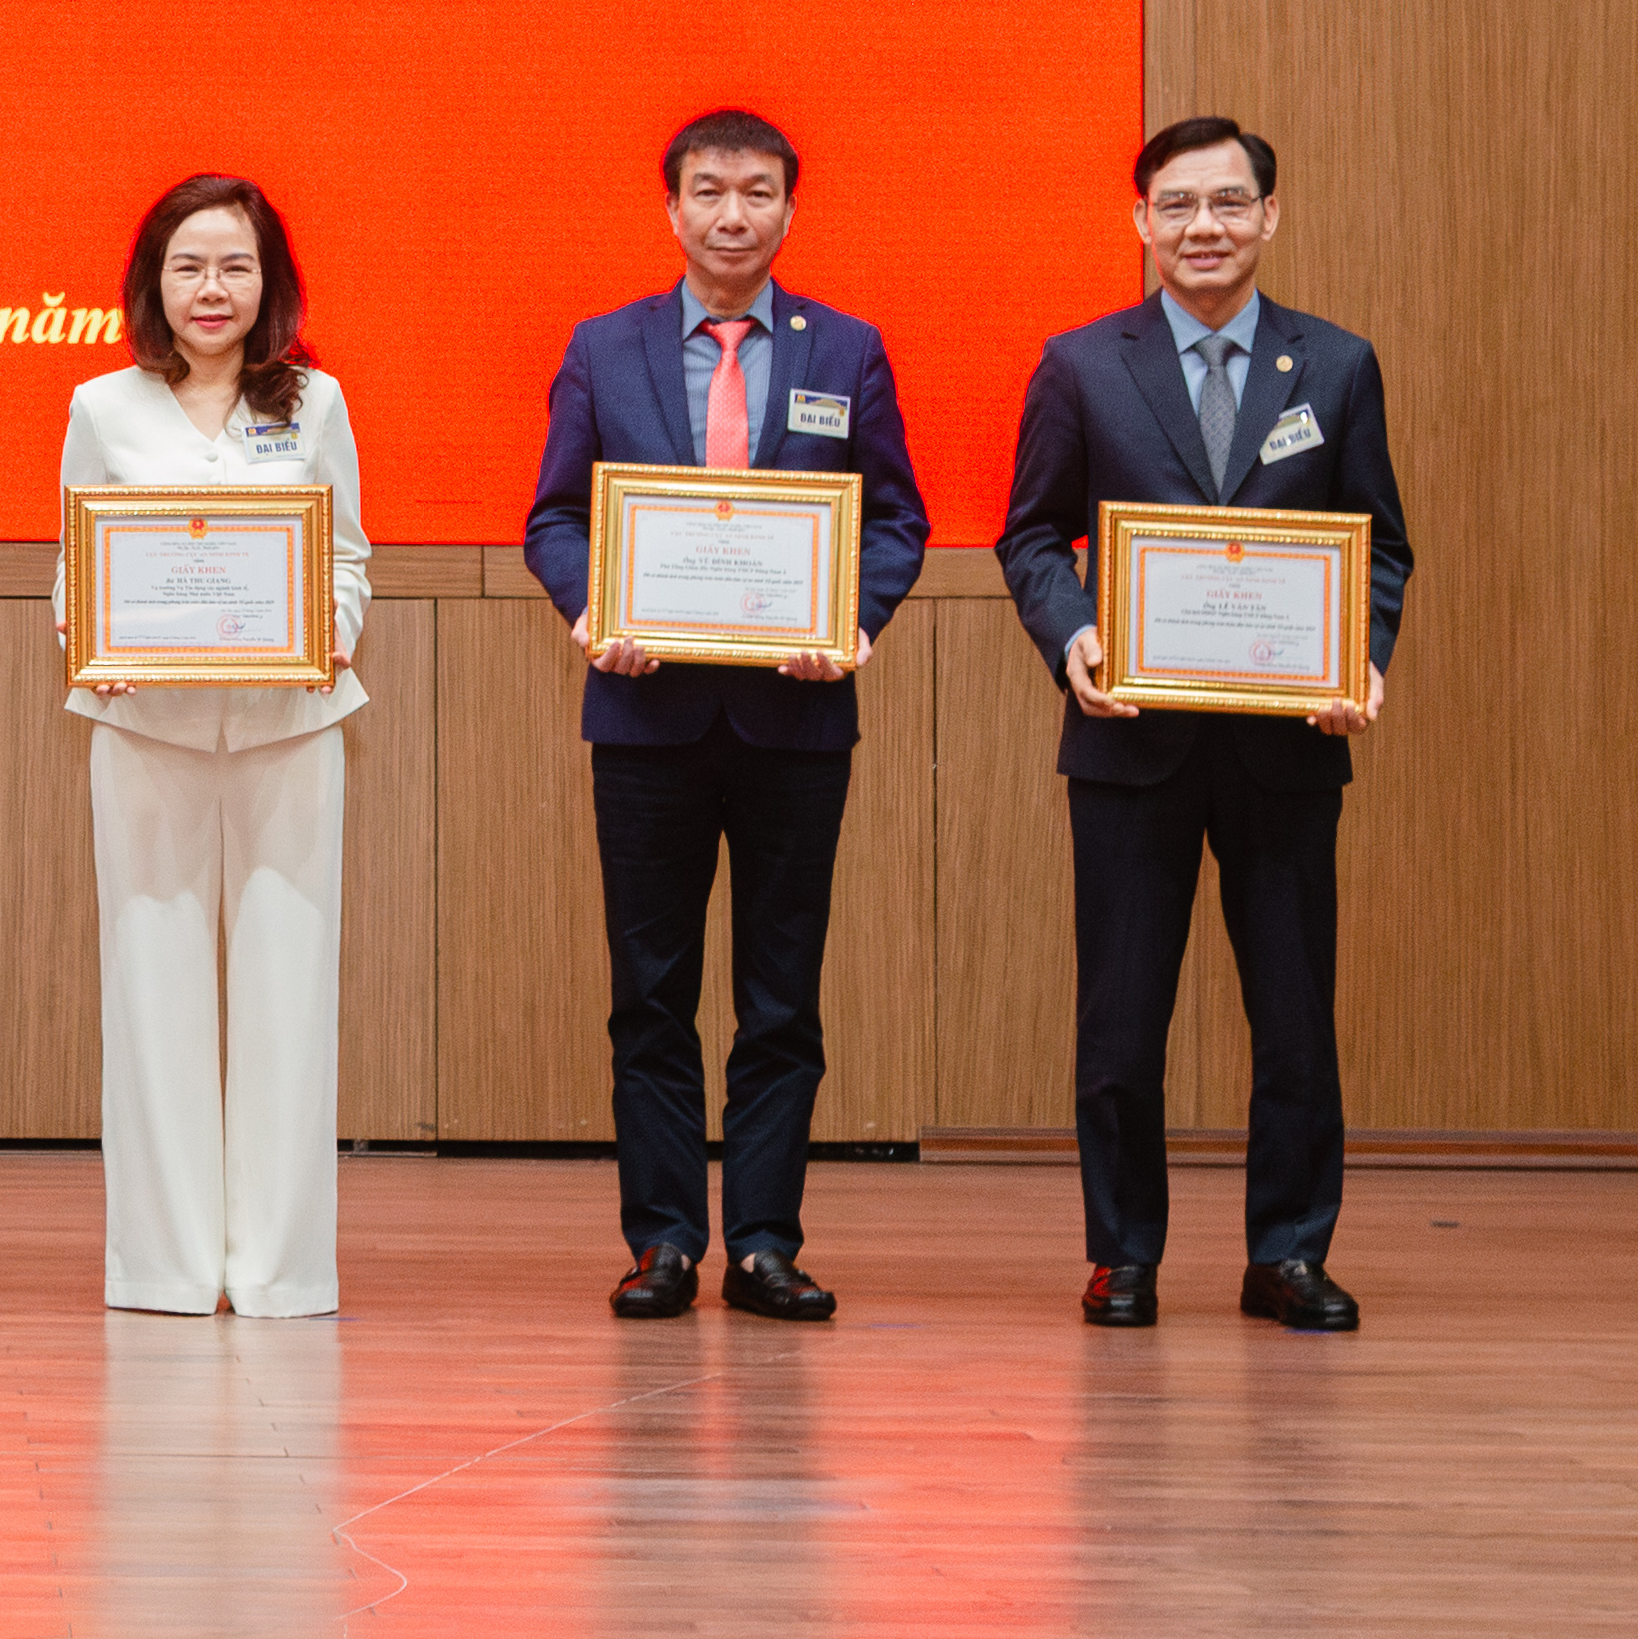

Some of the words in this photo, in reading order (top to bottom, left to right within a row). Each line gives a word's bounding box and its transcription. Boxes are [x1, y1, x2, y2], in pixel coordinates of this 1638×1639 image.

[256, 443, 273, 456] ĐẠI
[275, 440, 298, 452] BIỂU
[696, 544, 720, 554] GIẤY
[723, 547, 751, 556] KHEN
[171, 564, 196, 574] GIẤY
[198, 566, 226, 574] KHEN
